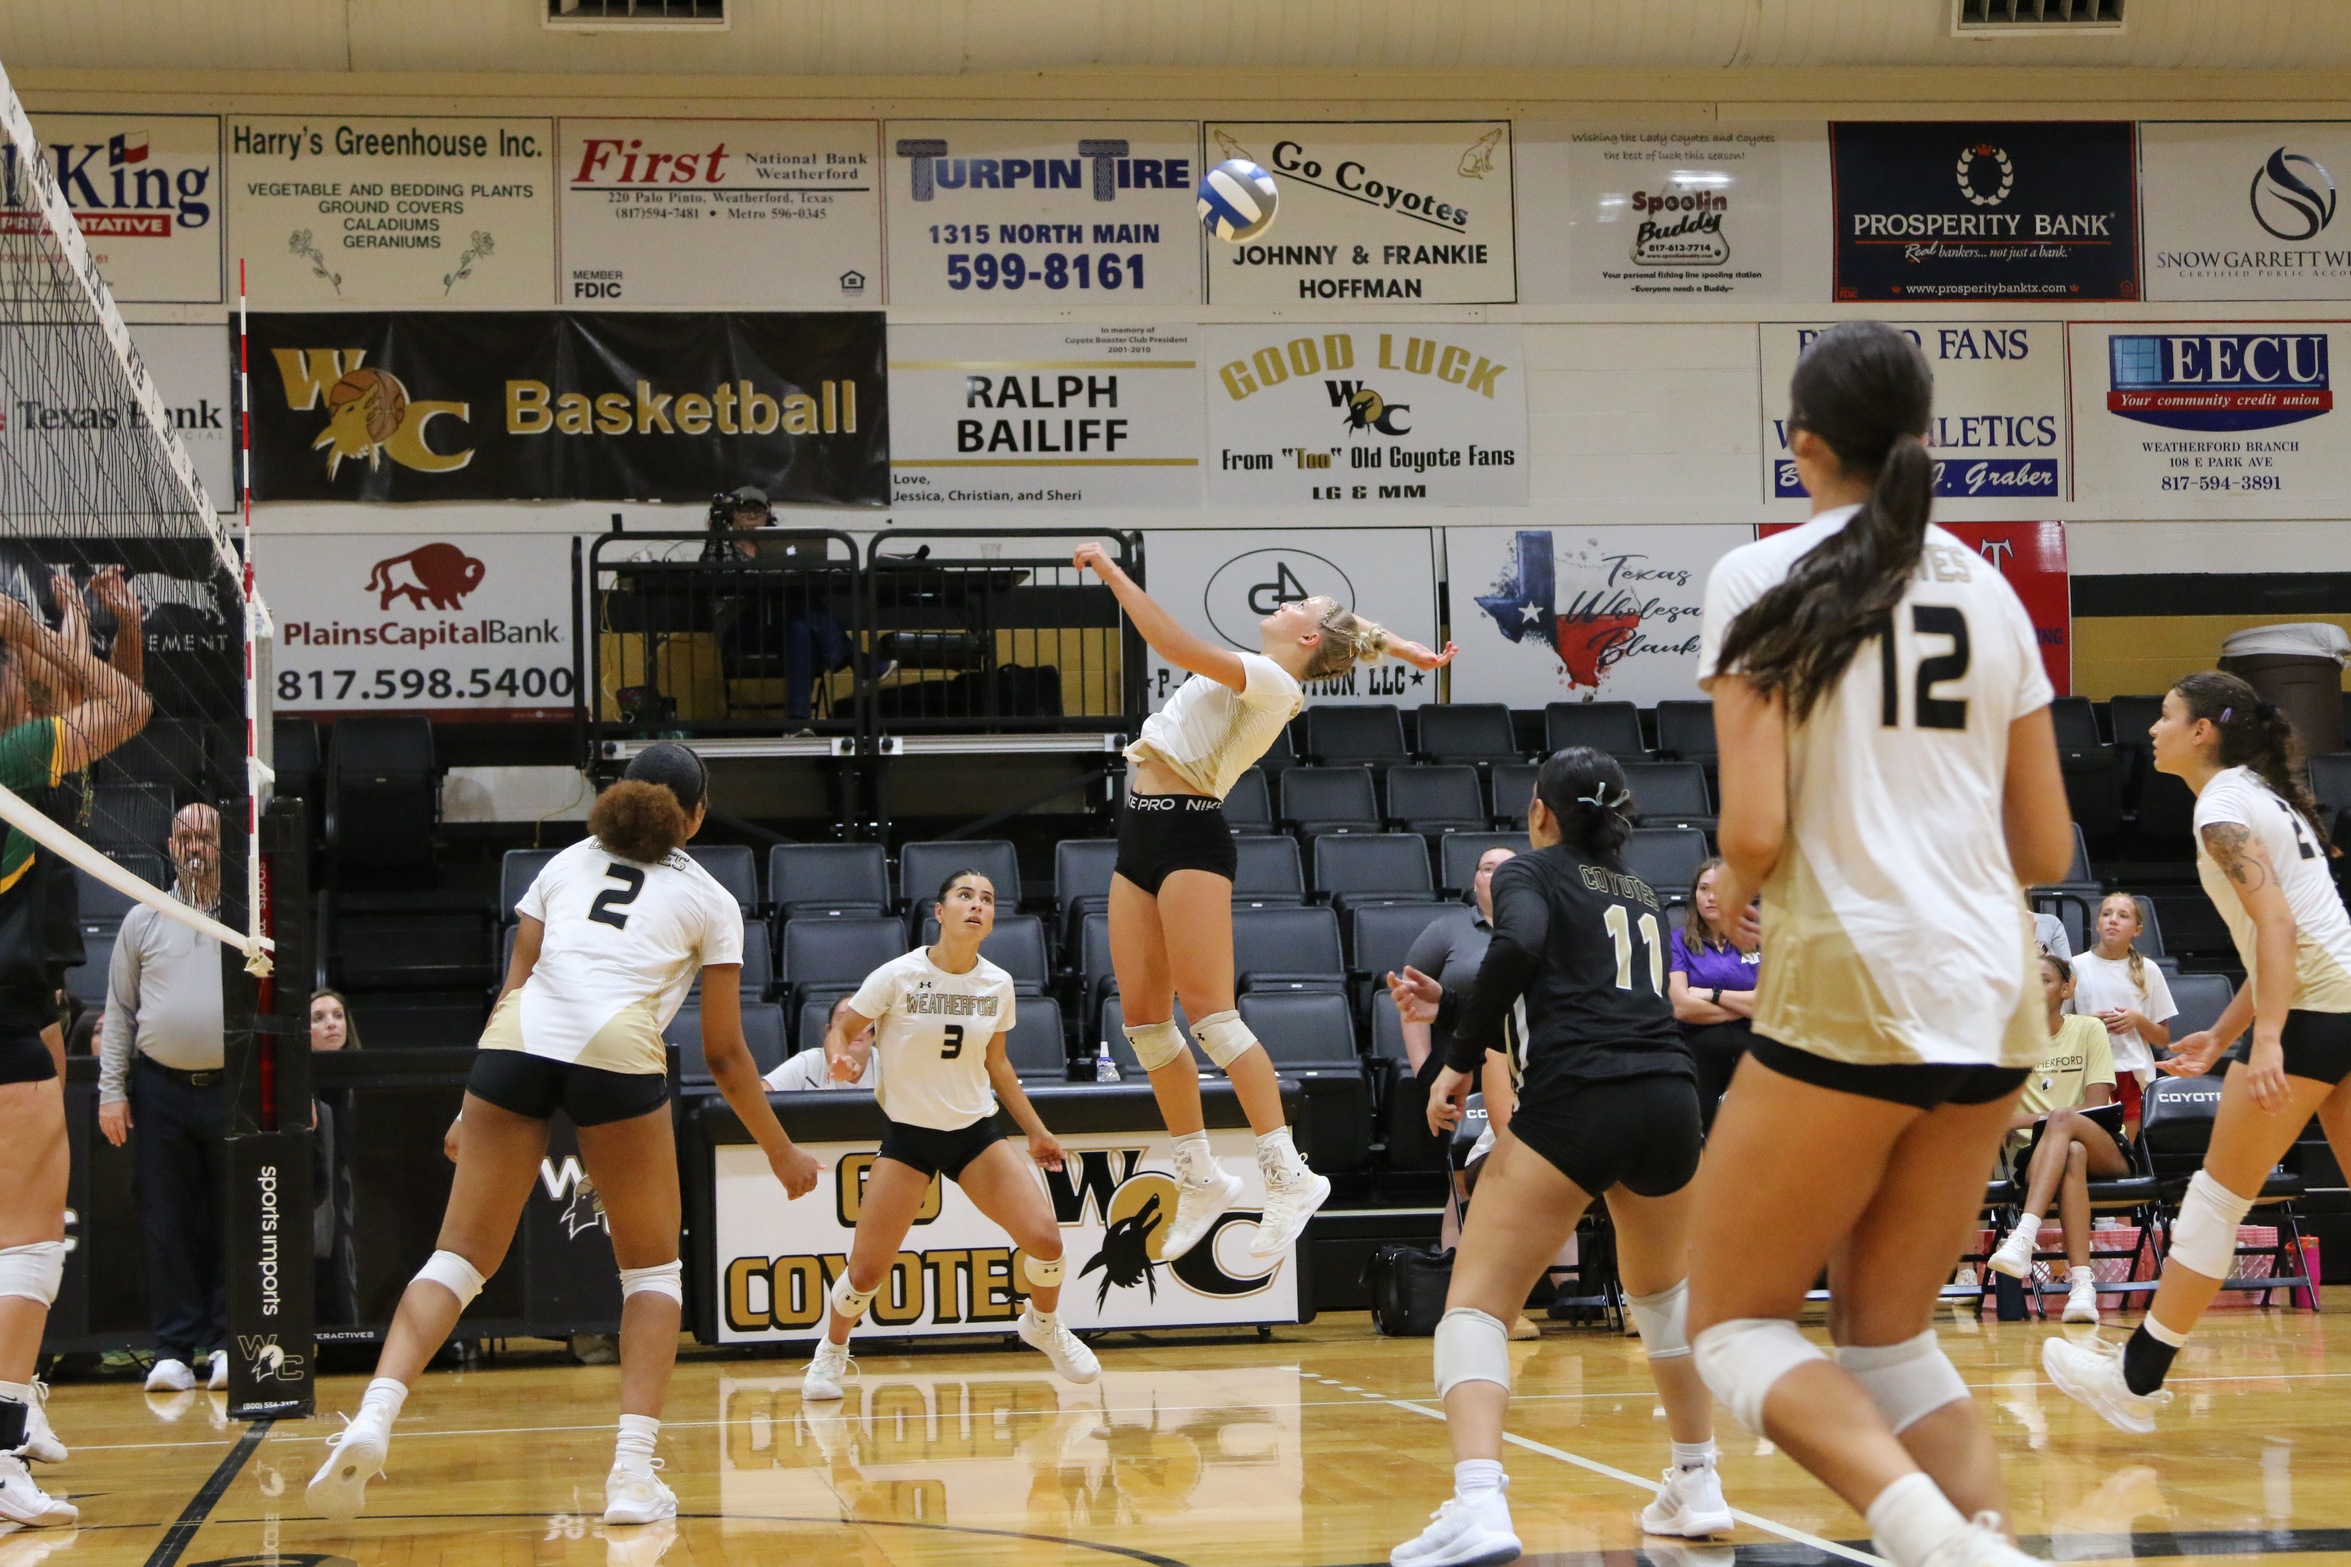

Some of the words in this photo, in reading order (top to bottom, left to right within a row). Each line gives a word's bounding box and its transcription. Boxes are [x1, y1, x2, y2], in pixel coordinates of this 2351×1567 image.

[234, 125, 323, 160] Harry's
[335, 126, 487, 156] Greenhouse
[499, 128, 543, 157] Inc.
[1572, 133, 1618, 144] Wishing
[1621, 133, 1637, 143] the
[1640, 133, 1668, 146] Lady
[1671, 133, 1710, 146] Coyotes
[1713, 133, 1733, 142] and
[1736, 134, 1776, 146] Coyotes
[571, 139, 730, 184] First
[745, 153, 817, 165] National
[826, 153, 868, 166] Bank
[1604, 151, 1620, 160] the
[1623, 151, 1643, 160] best
[1646, 151, 1656, 162] of
[1659, 151, 1682, 160] luck
[1685, 151, 1705, 160] this
[1708, 152, 1745, 161] season!
[756, 168, 859, 181] Weatherford
[895, 139, 1082, 202] TURPIN
[1078, 139, 1190, 202] TIRE
[1271, 140, 1322, 178] Go
[1335, 161, 1469, 226] Coyotes
[49, 143, 210, 228] King
[248, 184, 342, 197] VEGETABLE
[349, 184, 383, 197] AND
[390, 185, 464, 197] BEDDING
[471, 185, 534, 198] PLANTS
[318, 201, 389, 214] GROUND
[396, 201, 464, 214] COVERS
[608, 192, 630, 204] 220
[635, 192, 663, 204] Palo
[669, 192, 706, 205] Pinto,
[713, 192, 794, 206] Weatherford,
[801, 193, 834, 204] Texas
[1631, 190, 1728, 215] Spoolin
[343, 218, 440, 231] CALADIUMS
[615, 207, 700, 220] (817)594-7481
[727, 208, 766, 220] Metro
[771, 208, 827, 220] 596-0345
[1854, 214, 2021, 236] PROSPERITY
[2034, 214, 2109, 236] BANK
[929, 224, 990, 244] 1315
[1000, 224, 1083, 244] NORTH
[1093, 224, 1160, 244] MAIN
[1637, 211, 1722, 243] Buddy
[343, 235, 441, 249] GERANIUMS
[1904, 241, 1938, 263] Real
[1938, 244, 1987, 258] bankers...
[1989, 245, 2006, 258] not
[2007, 245, 2026, 261] just
[2029, 249, 2037, 258] a
[2038, 244, 2068, 258] bank.
[1232, 245, 1338, 266] JOHNNY
[1352, 245, 1369, 265] &
[1384, 245, 1487, 265] FRANKIE
[2157, 251, 2220, 268] SNOW
[2224, 251, 2321, 268] GARRETT
[573, 270, 623, 280] MEMBER
[947, 253, 1144, 291] 599-8161
[1623, 272, 1656, 280] personal
[1657, 271, 1684, 280] fishing
[1701, 272, 1733, 280] spooling
[574, 283, 622, 299] FDIC
[1300, 278, 1422, 299] HOFFMAN
[1906, 283, 2066, 295] www.prosperitybanktx.com
[1938, 329, 2029, 360] FANS
[1219, 333, 1354, 401] GOOD
[1378, 333, 1508, 400] LUCK
[2167, 337, 2323, 383] EECU
[966, 375, 1117, 408] RALPH
[2121, 394, 2152, 406] Your
[2157, 394, 2231, 407] community
[2237, 392, 2276, 405] credit
[2283, 393, 2320, 405] union
[16, 401, 118, 430] Texas
[130, 400, 223, 429] bnk
[506, 380, 857, 435] Basketball
[957, 419, 1128, 453] BAILIFF
[1928, 415, 2057, 448] LETICS
[1222, 449, 1273, 470] From
[1351, 446, 1382, 468] Old
[1389, 446, 1461, 473] Coyote
[1468, 444, 1515, 466] Fans
[2142, 442, 2241, 453] WEATHERFORD
[2246, 442, 2299, 452] BRANCH
[2169, 457, 2189, 468] 108
[2195, 458, 2202, 467] E
[2208, 457, 2242, 468] PARK
[2248, 457, 2273, 467] AVE
[893, 474, 931, 486] Love,
[1964, 461, 2054, 495] Graber
[2161, 475, 2282, 491] 817-594-3891
[892, 490, 945, 503] Jessica,
[948, 490, 1014, 502] Christian,
[1017, 490, 1043, 501] and
[1047, 489, 1082, 501] Sheri
[1312, 487, 1341, 500] LG
[1379, 485, 1426, 499] MM
[1600, 554, 1692, 588] Texas
[1565, 590, 1703, 625] Wholesa
[284, 619, 560, 650] PlainsCapitalBank
[1586, 626, 1703, 667] Blank
[1874, 604, 1971, 730] 12
[278, 667, 574, 701] 817.598.5400
[1369, 666, 1406, 696] LLC
[1137, 798, 1176, 811] PRO
[587, 862, 645, 931] 2
[1578, 864, 1660, 912] COYOTES
[1603, 904, 1663, 999] 11
[906, 993, 999, 1016] WEATHERFORD
[941, 1024, 964, 1059] 3
[257, 1165, 280, 1232] sports
[258, 1235, 281, 1316] imports
[243, 1402, 263, 1410] (800)
